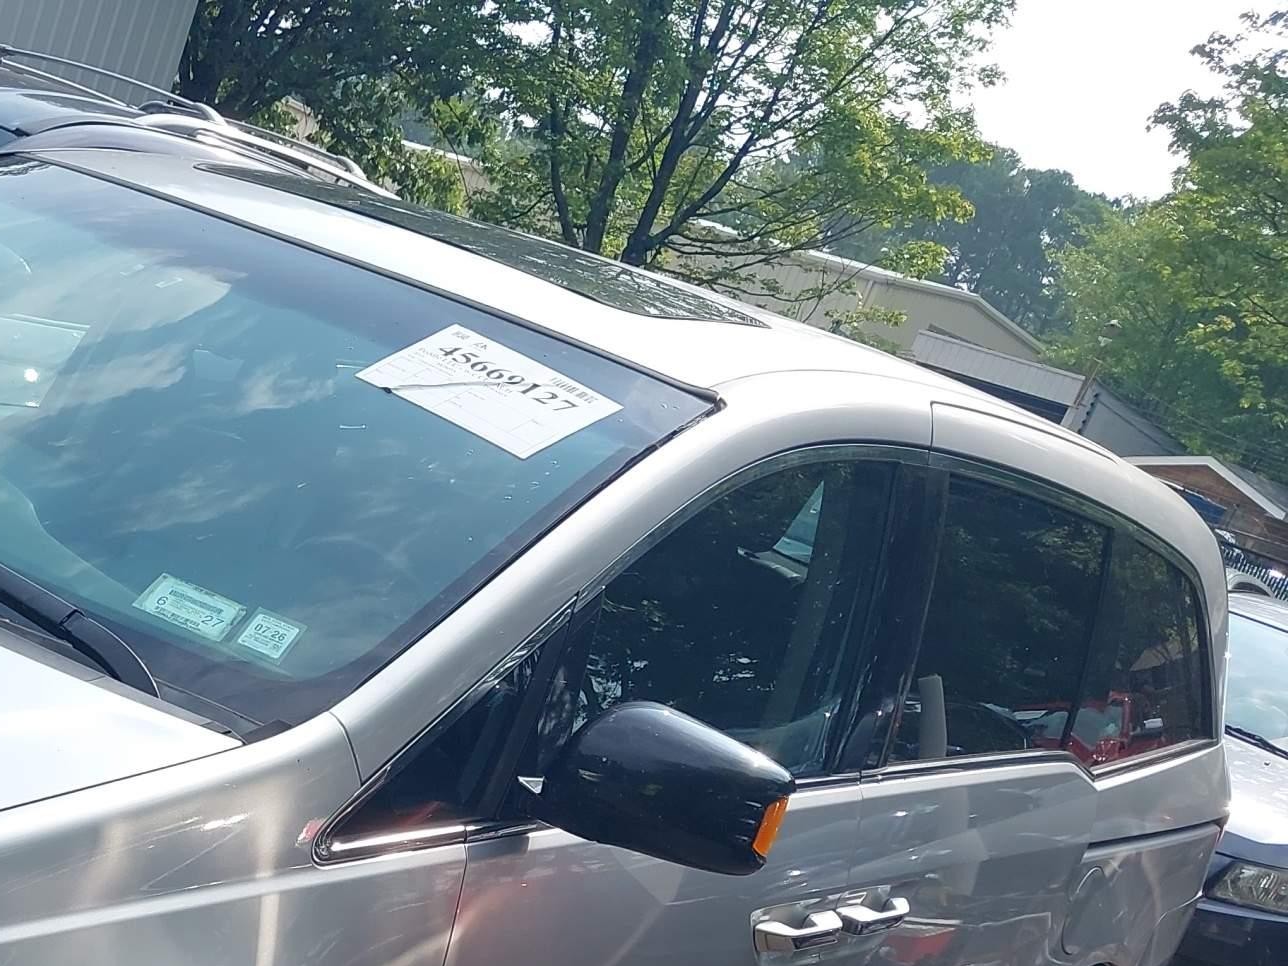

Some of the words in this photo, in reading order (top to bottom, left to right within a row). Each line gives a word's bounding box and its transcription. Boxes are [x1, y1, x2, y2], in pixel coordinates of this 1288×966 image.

[438, 346, 580, 412] 45669127
[156, 596, 169, 606] 6
[201, 615, 225, 627] 27
[254, 623, 271, 634] 07
[271, 630, 287, 641] 26
